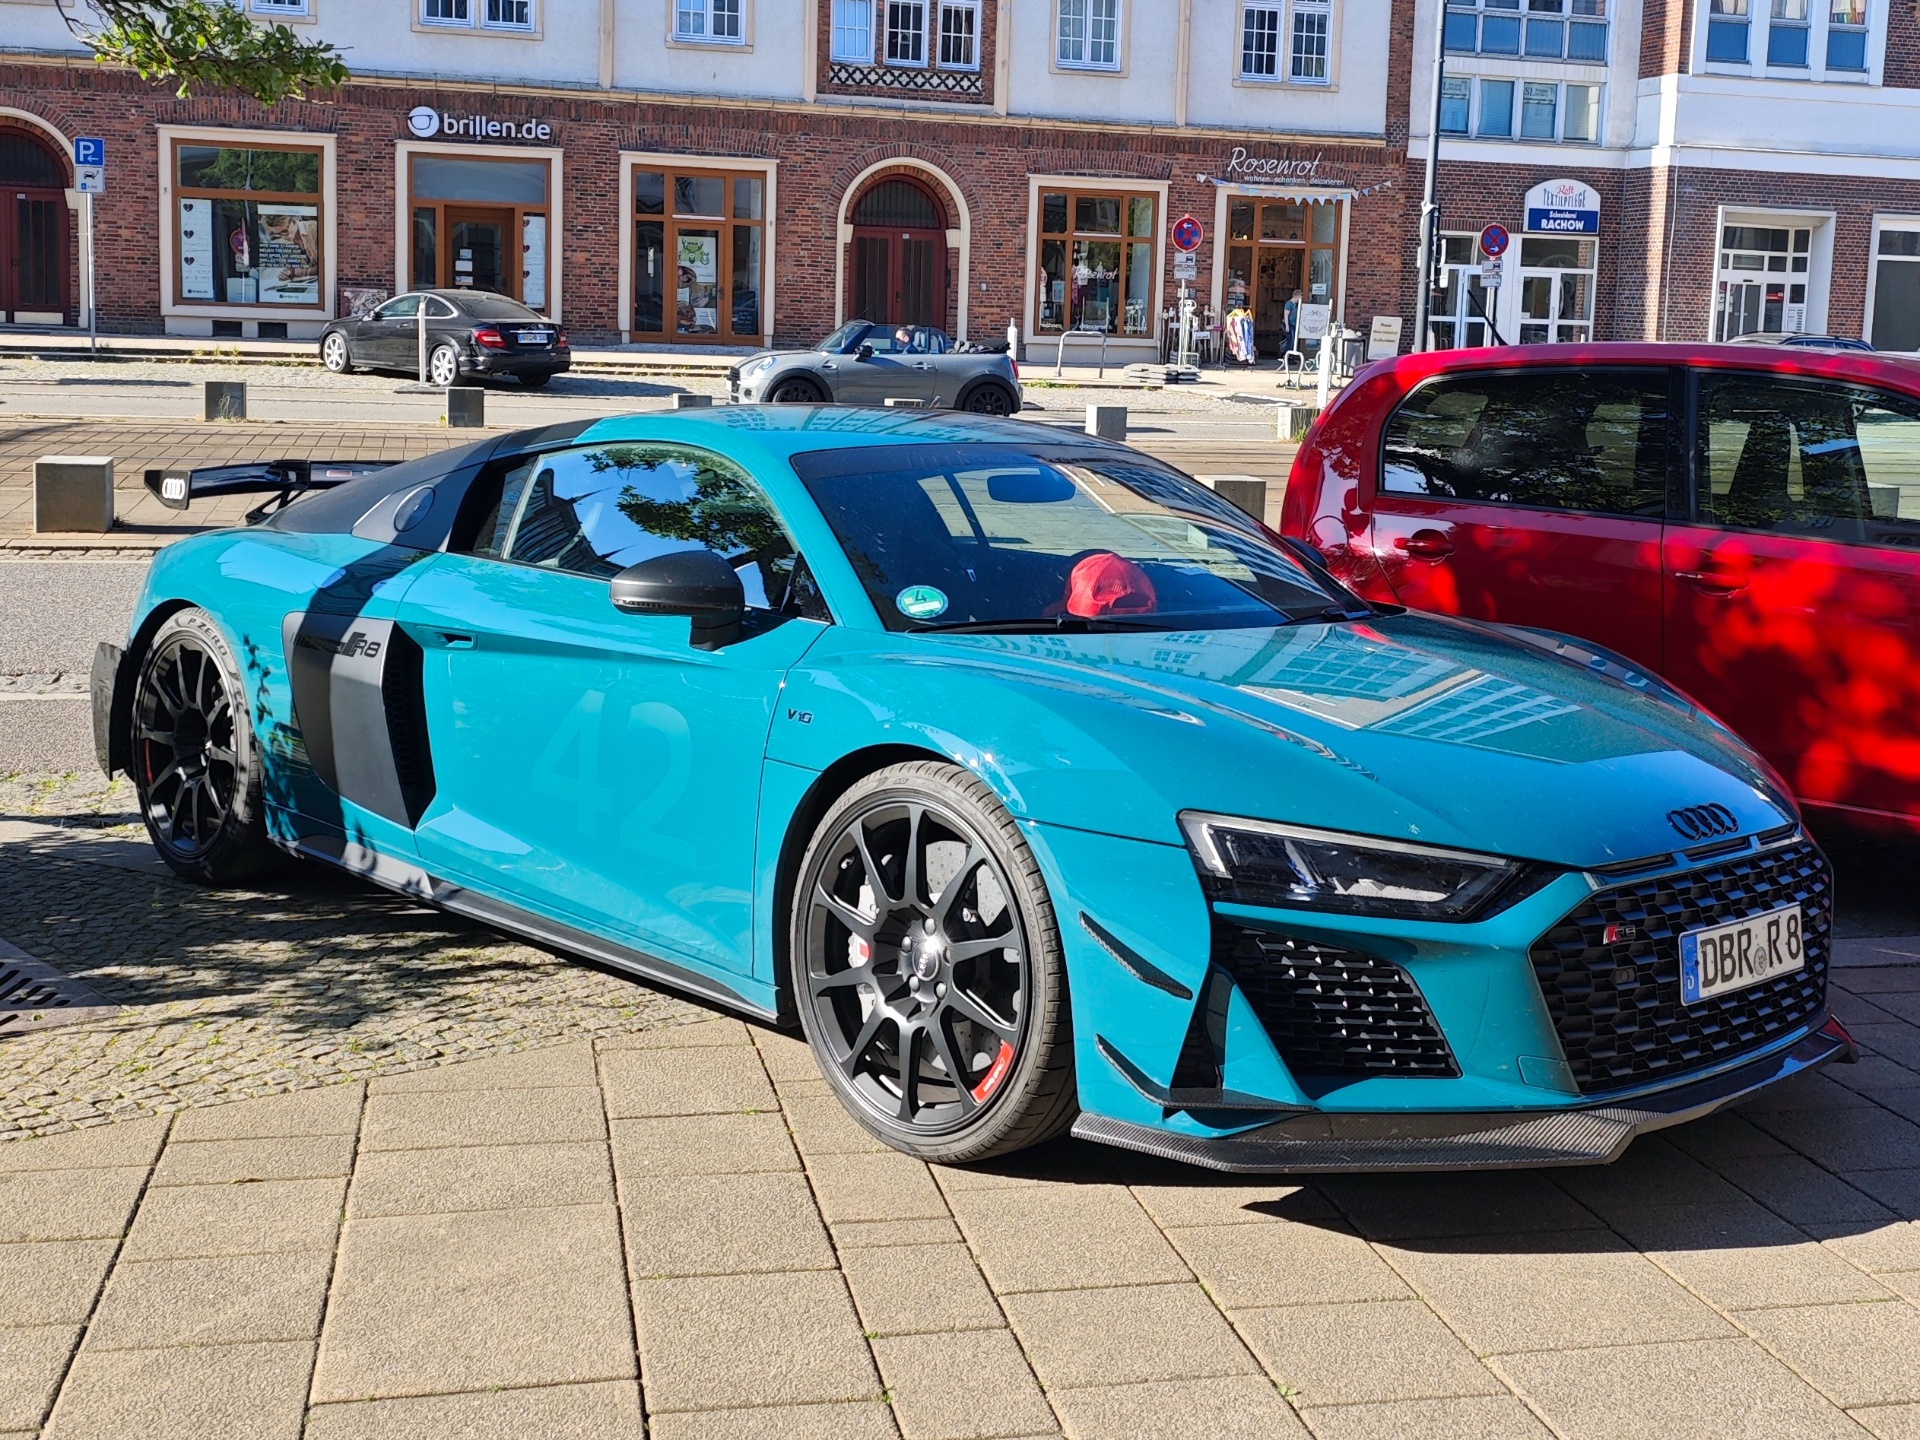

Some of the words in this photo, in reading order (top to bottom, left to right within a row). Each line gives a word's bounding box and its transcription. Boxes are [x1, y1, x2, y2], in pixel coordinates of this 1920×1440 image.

[443, 113, 551, 140] brillen.de
[79, 141, 95, 161] P
[1227, 147, 1322, 176] Rosenrot
[1541, 218, 1585, 231] RACHOW
[196, 621, 229, 657] ZERO
[350, 638, 382, 658] R8
[787, 708, 813, 724] V10
[531, 689, 698, 870] 42
[1701, 927, 1755, 989] DBR
